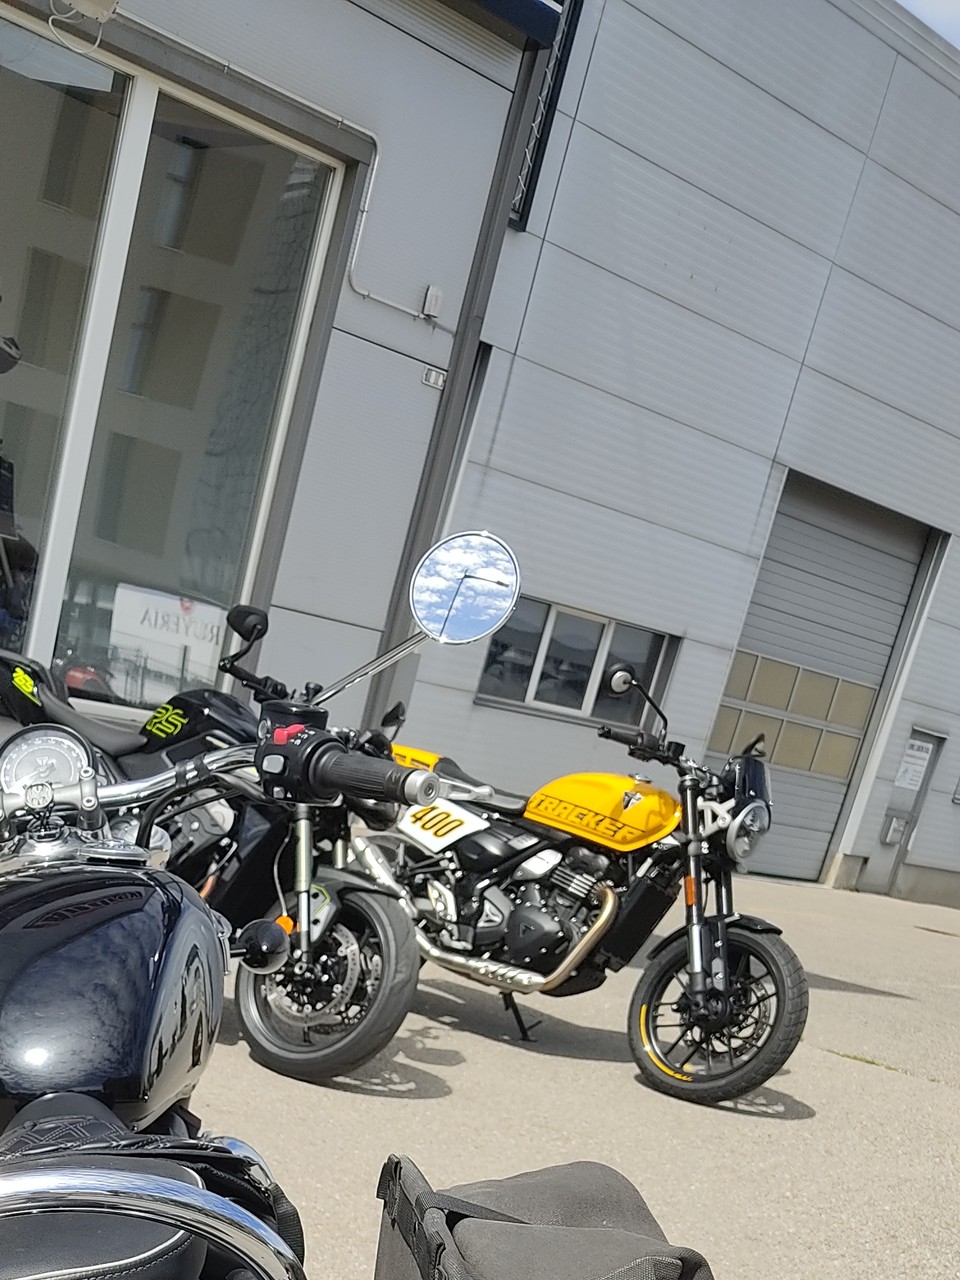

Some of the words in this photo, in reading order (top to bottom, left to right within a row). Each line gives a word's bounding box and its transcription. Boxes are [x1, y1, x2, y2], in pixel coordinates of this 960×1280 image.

[12, 667, 36, 693] 765
[411, 805, 465, 838] 400
[527, 794, 642, 843] TRACKER
